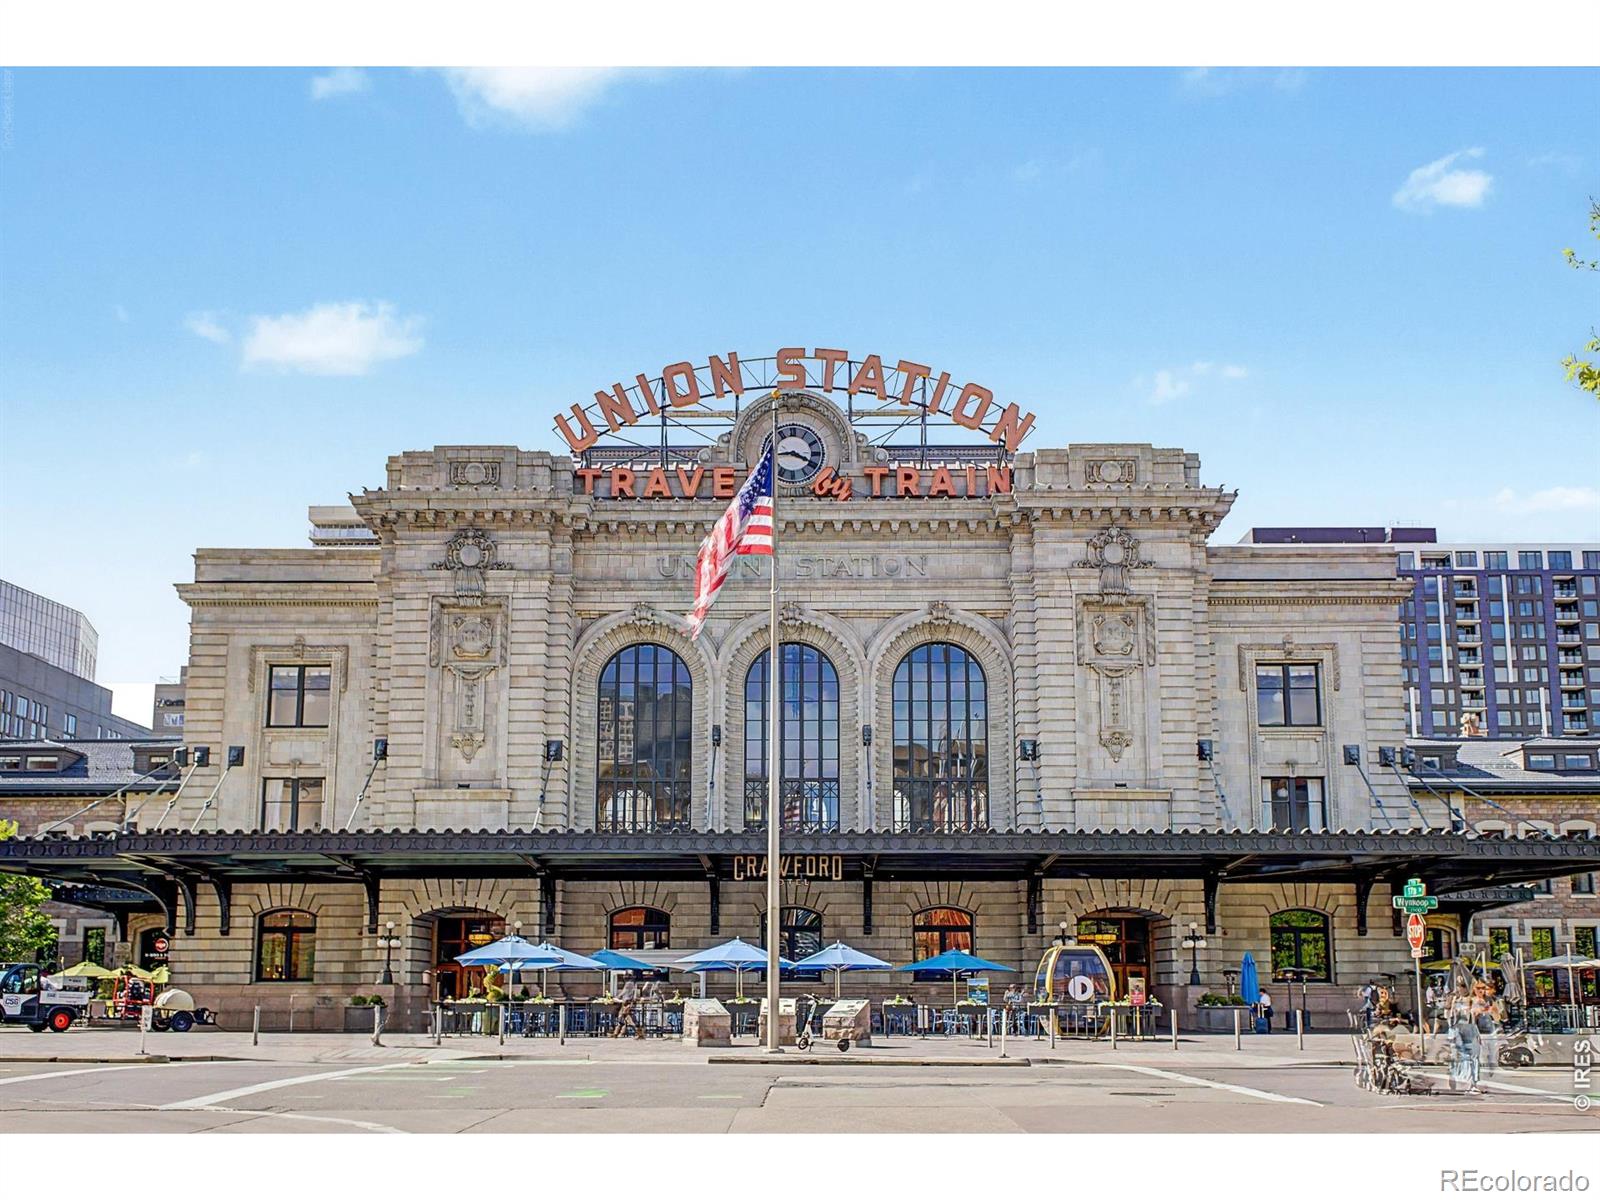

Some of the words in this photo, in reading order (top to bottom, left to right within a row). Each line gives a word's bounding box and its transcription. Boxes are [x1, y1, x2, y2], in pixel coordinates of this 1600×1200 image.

[553, 352, 744, 453] UNION
[777, 347, 1036, 453] STATION
[577, 467, 755, 497] TRAVE
[810, 466, 852, 500] by
[864, 466, 1011, 497] TRAIN
[656, 556, 764, 578] UNN
[796, 556, 927, 578] STATION
[1397, 897, 1429, 908] Wynkoop
[1408, 926, 1422, 939] STOP
